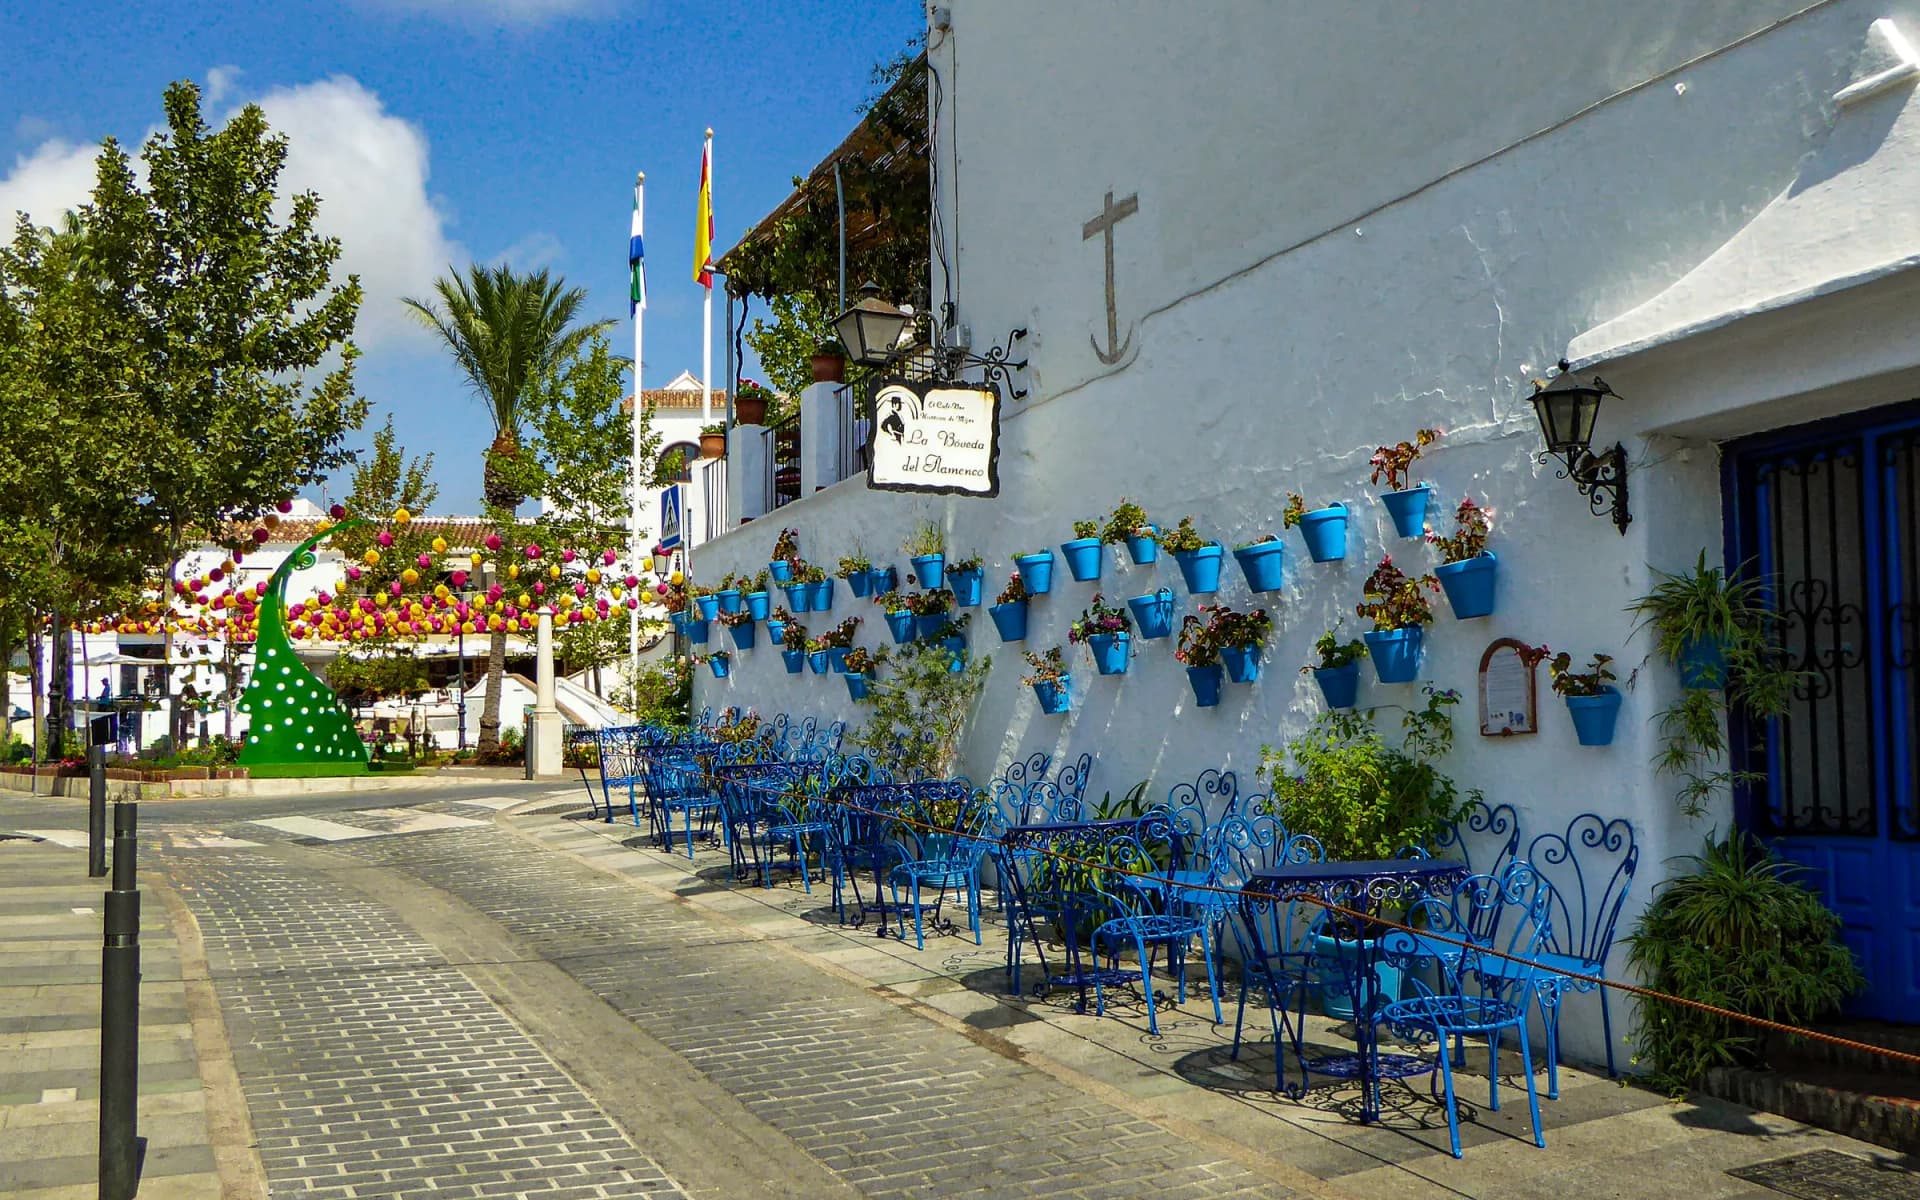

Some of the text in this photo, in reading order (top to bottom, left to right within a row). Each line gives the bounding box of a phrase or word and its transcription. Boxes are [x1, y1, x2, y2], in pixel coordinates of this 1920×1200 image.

[906, 429, 985, 450] La Bóveda
[902, 453, 985, 477] del Flamenco
